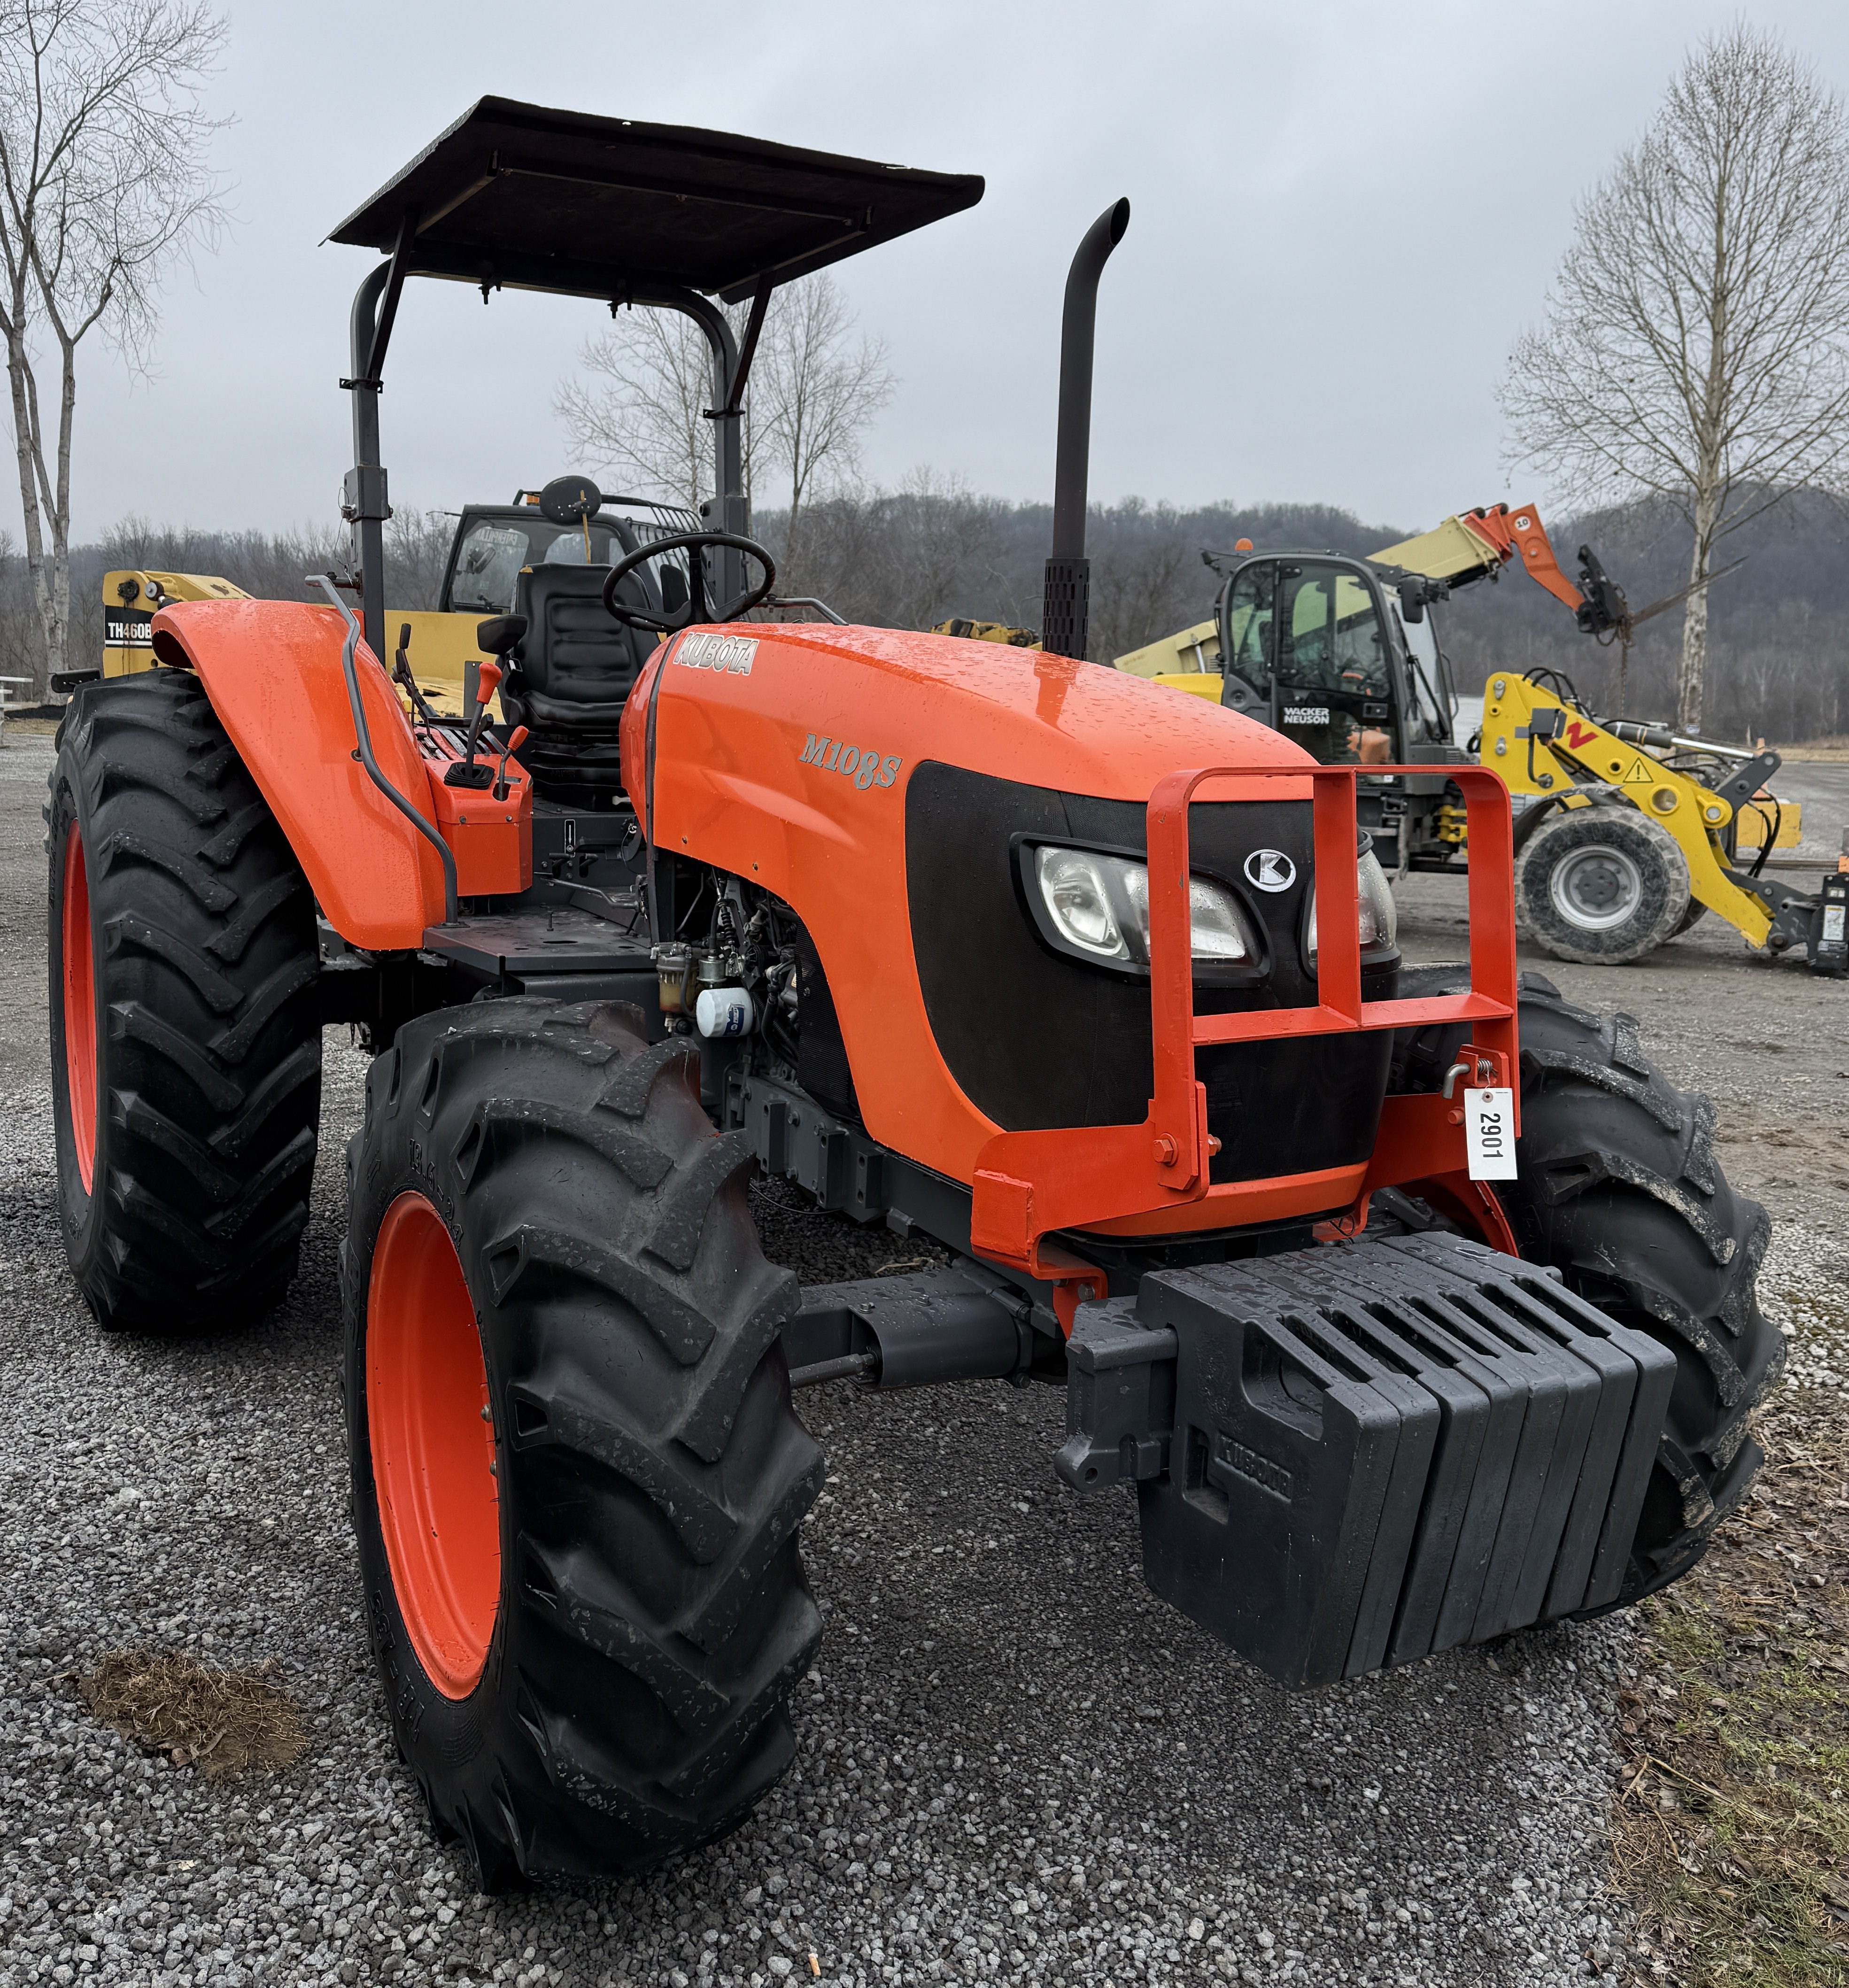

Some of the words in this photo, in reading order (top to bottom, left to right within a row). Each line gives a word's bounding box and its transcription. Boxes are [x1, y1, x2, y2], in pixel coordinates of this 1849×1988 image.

[108, 622, 151, 639] TH460B
[673, 632, 759, 676] KUBOTA
[1284, 715, 1330, 724] NEUSON
[798, 733, 903, 790] M108S
[1480, 1113, 1503, 1158] 2901
